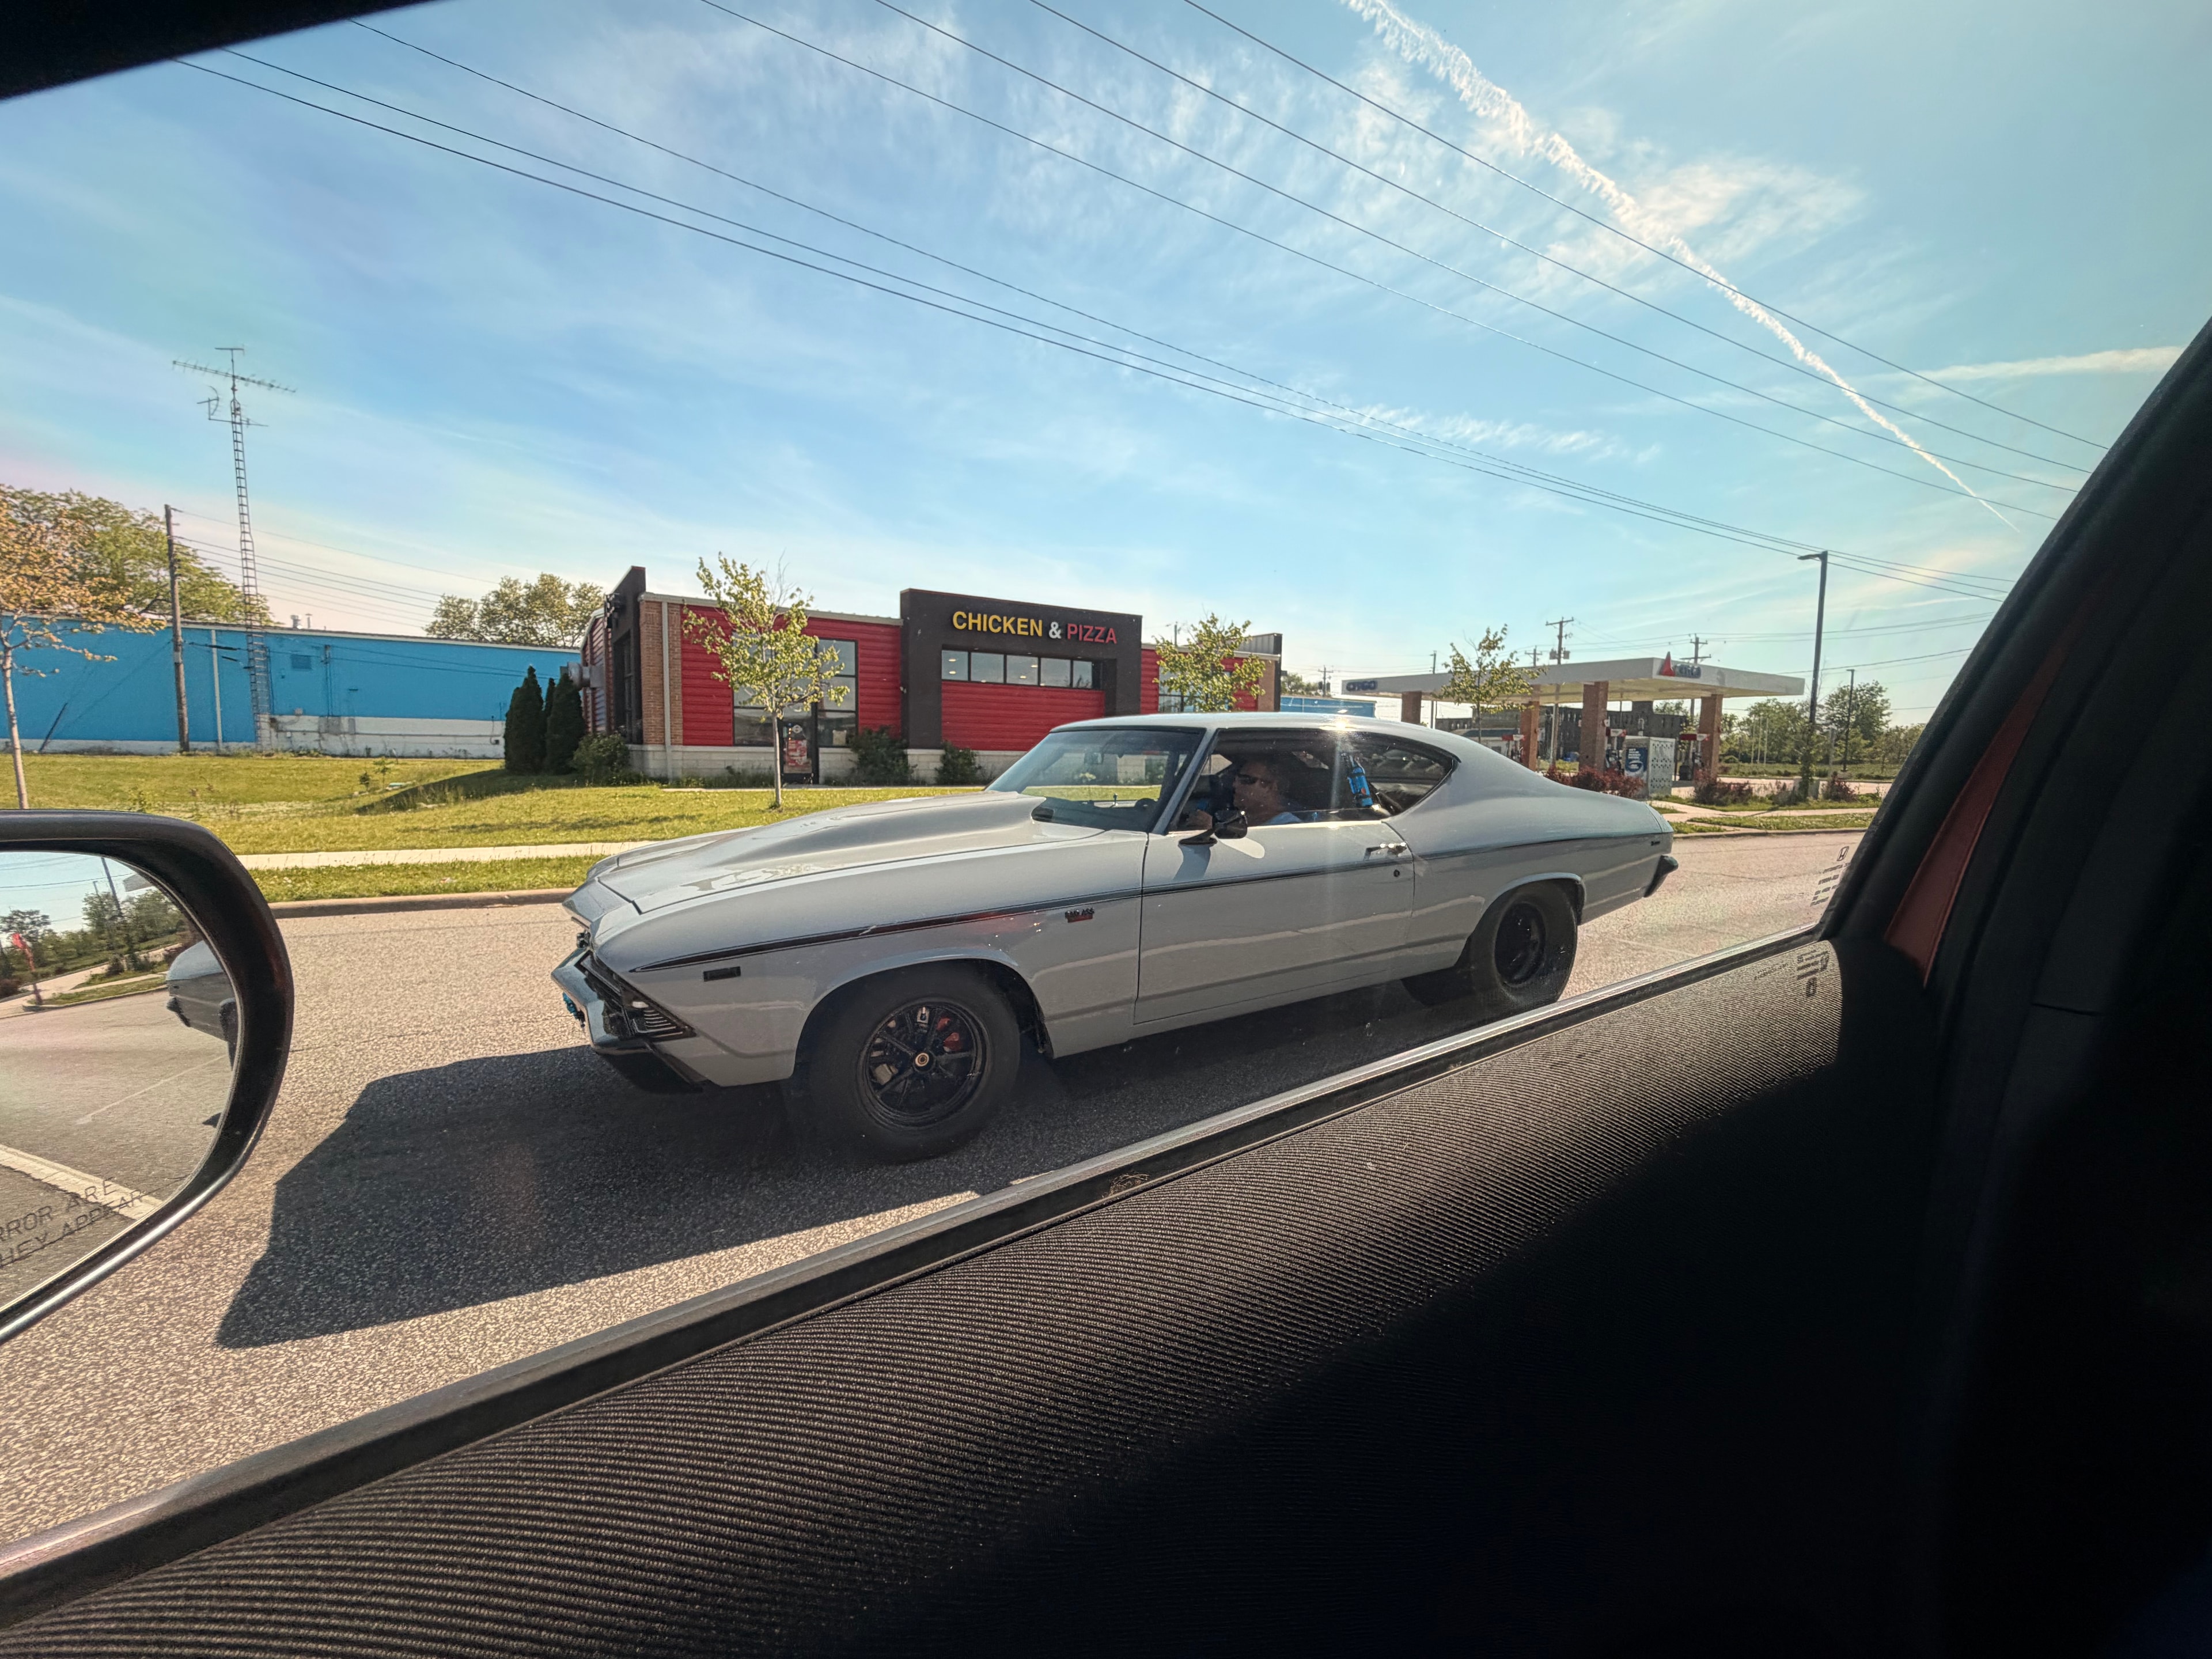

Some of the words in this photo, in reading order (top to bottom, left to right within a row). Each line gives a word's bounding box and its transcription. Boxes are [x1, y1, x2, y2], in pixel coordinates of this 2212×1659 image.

[953, 611, 1043, 637] CHICKEN
[1048, 621, 1062, 639] &
[1067, 623, 1117, 644] PIZZA
[66, 1176, 116, 1213] ARE
